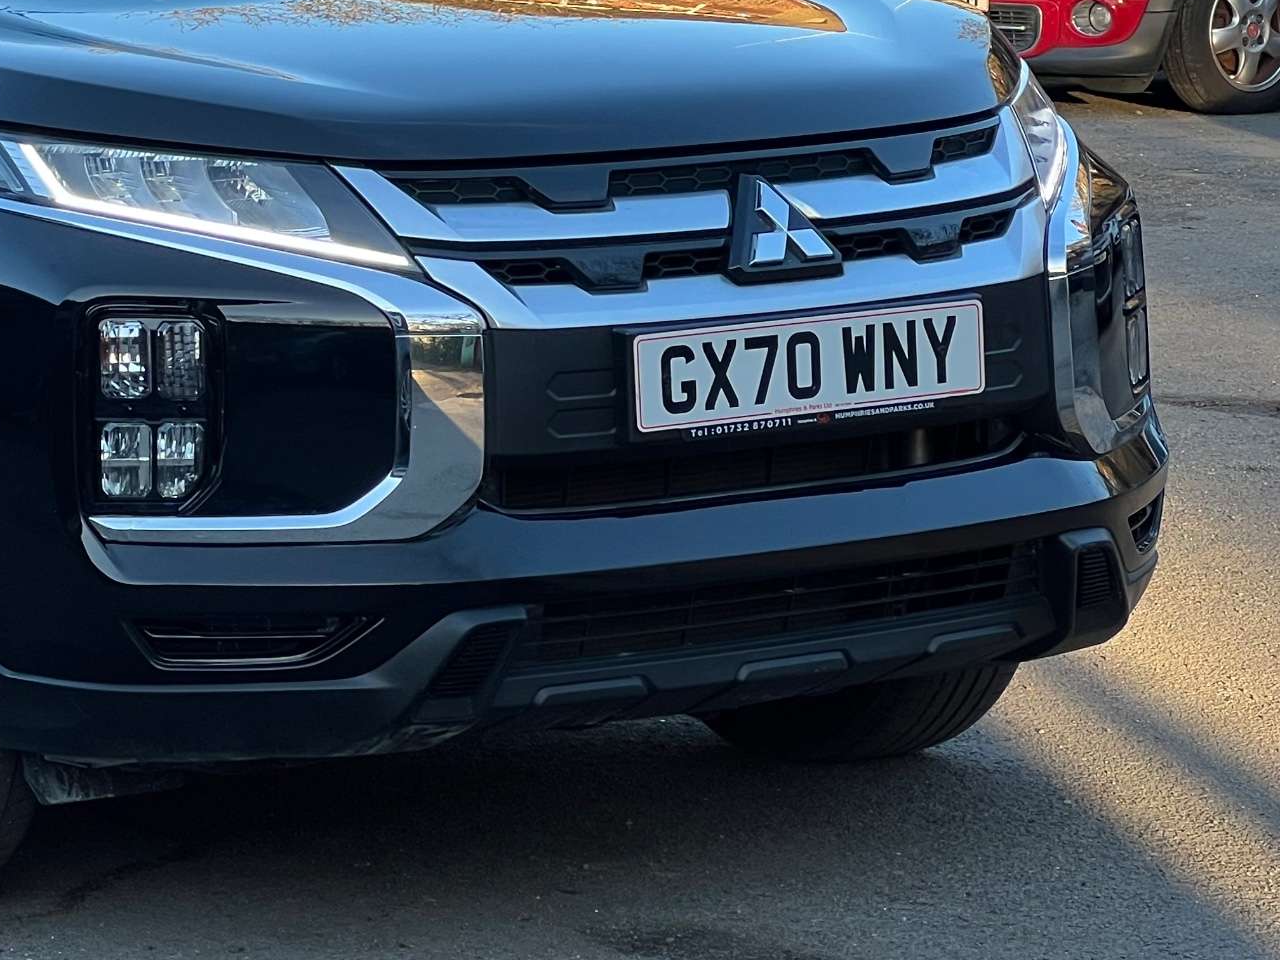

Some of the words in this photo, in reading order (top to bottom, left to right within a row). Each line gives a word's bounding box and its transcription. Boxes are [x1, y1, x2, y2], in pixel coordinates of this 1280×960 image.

[660, 331, 822, 415] GX70
[841, 315, 957, 395] WNY
[834, 401, 935, 420] HUMPHRIESANDPARKS.CO.UK
[752, 418, 792, 430] 870711
